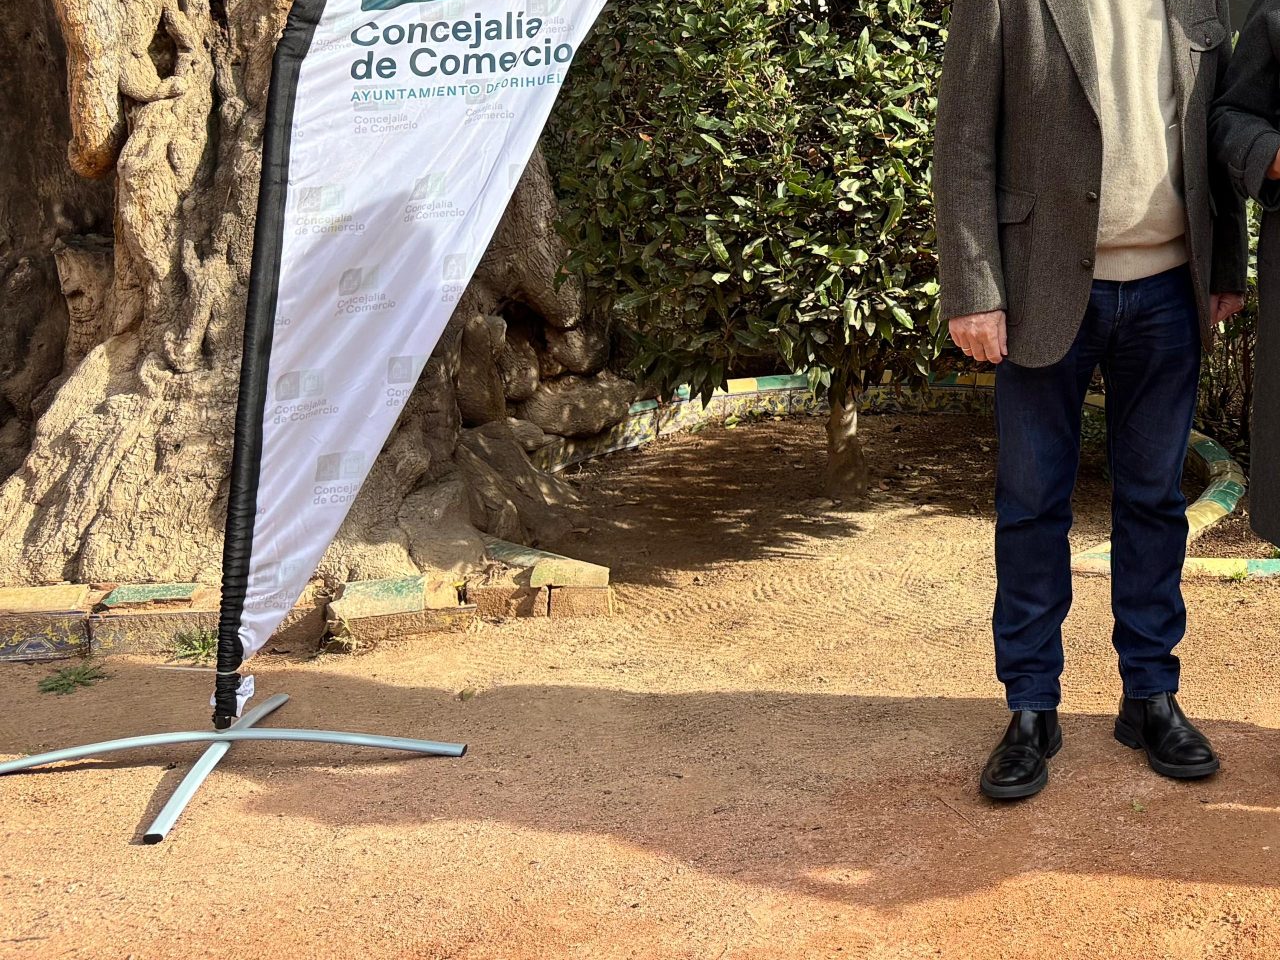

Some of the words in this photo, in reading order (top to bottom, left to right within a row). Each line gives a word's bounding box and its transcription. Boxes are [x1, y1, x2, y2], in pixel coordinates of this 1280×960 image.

[350, 11, 543, 49] Concejalía
[350, 50, 397, 80] de
[350, 84, 481, 102] AYUNTAMIENTO
[501, 73, 564, 88] ORIHUEL
[354, 125, 368, 134] de
[371, 121, 418, 133] Comercio
[295, 227, 308, 235] de
[312, 222, 366, 234] Comercio
[274, 416, 287, 424] de
[313, 496, 327, 505] de
